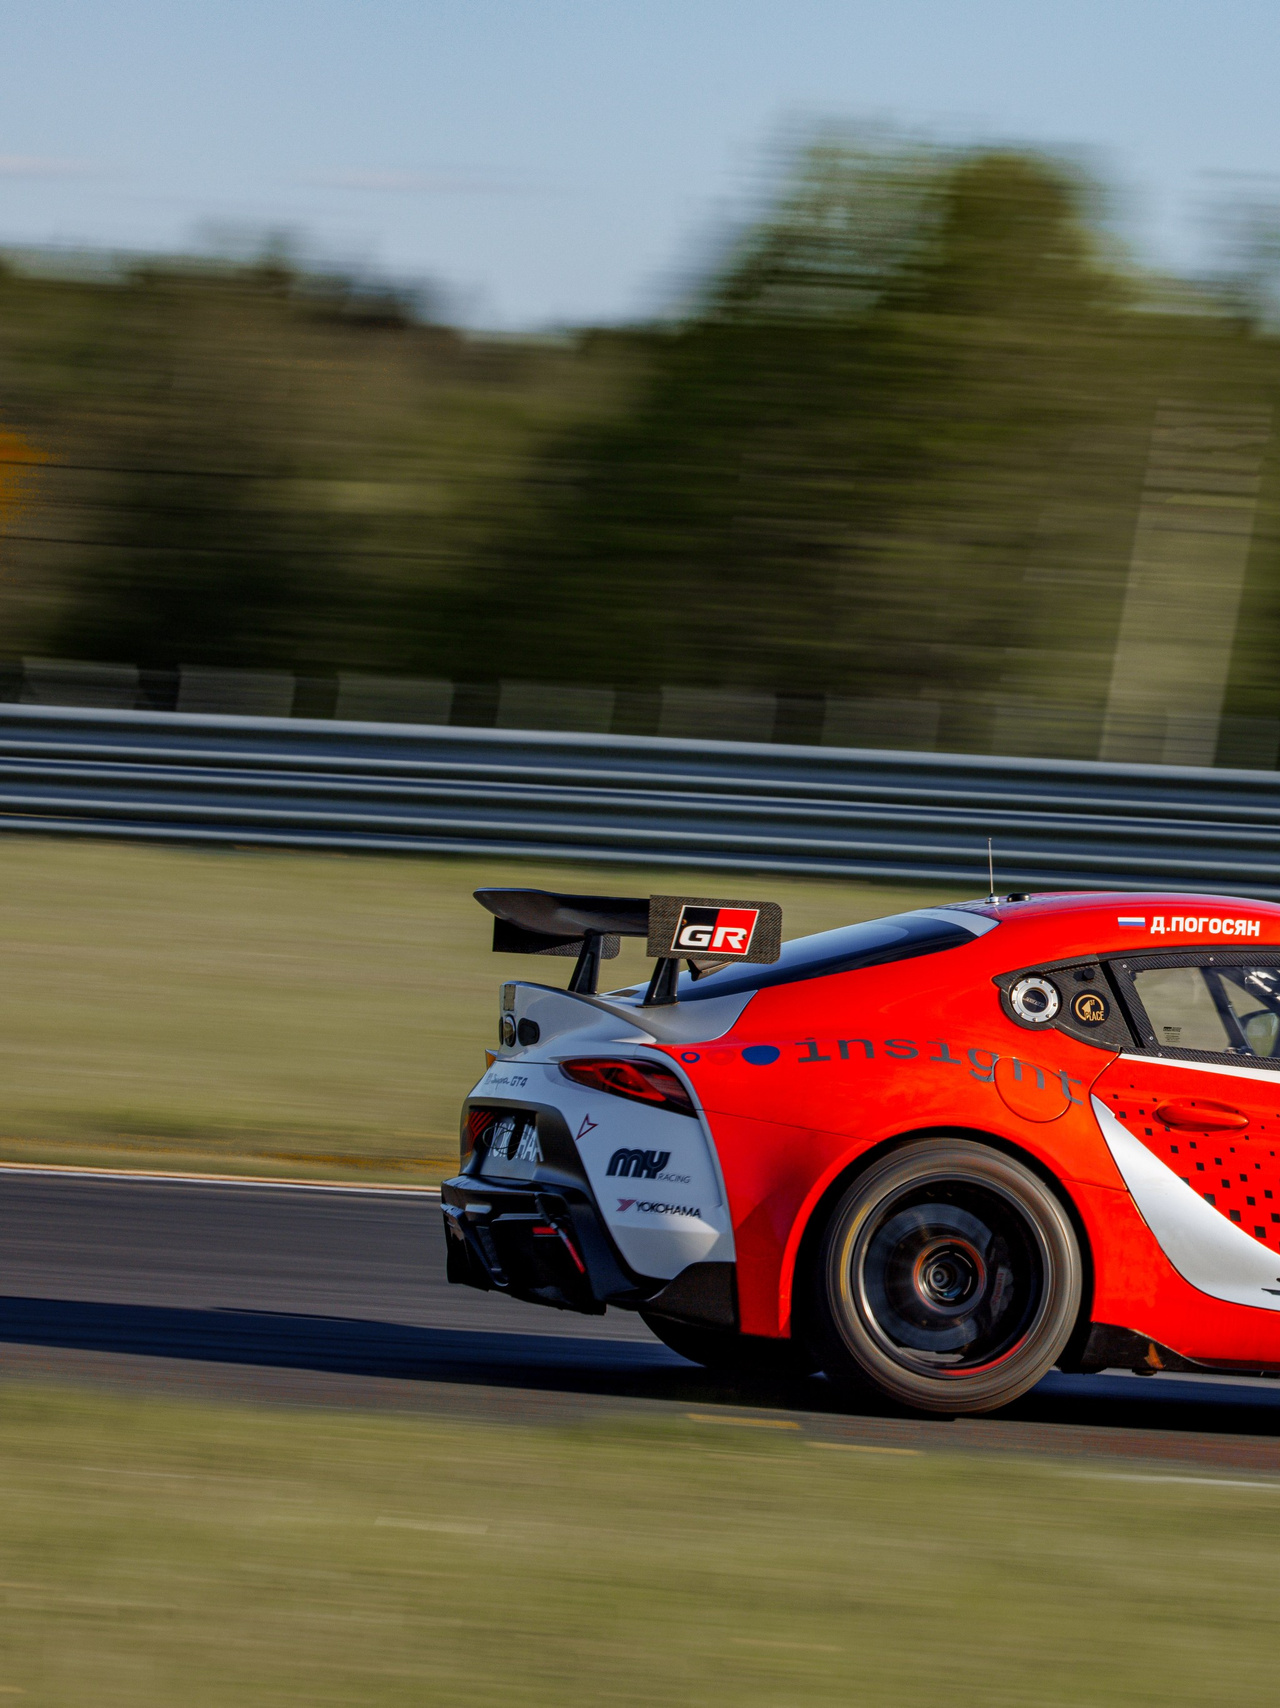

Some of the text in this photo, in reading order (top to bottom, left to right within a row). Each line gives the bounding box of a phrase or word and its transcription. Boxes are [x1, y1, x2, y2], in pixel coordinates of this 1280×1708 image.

[1150, 916, 1261, 937] Д.ПОГОСЯН
[679, 925, 748, 949] GR
[658, 1173, 691, 1183] RACING
[636, 1201, 702, 1218] YOKOHAMA
